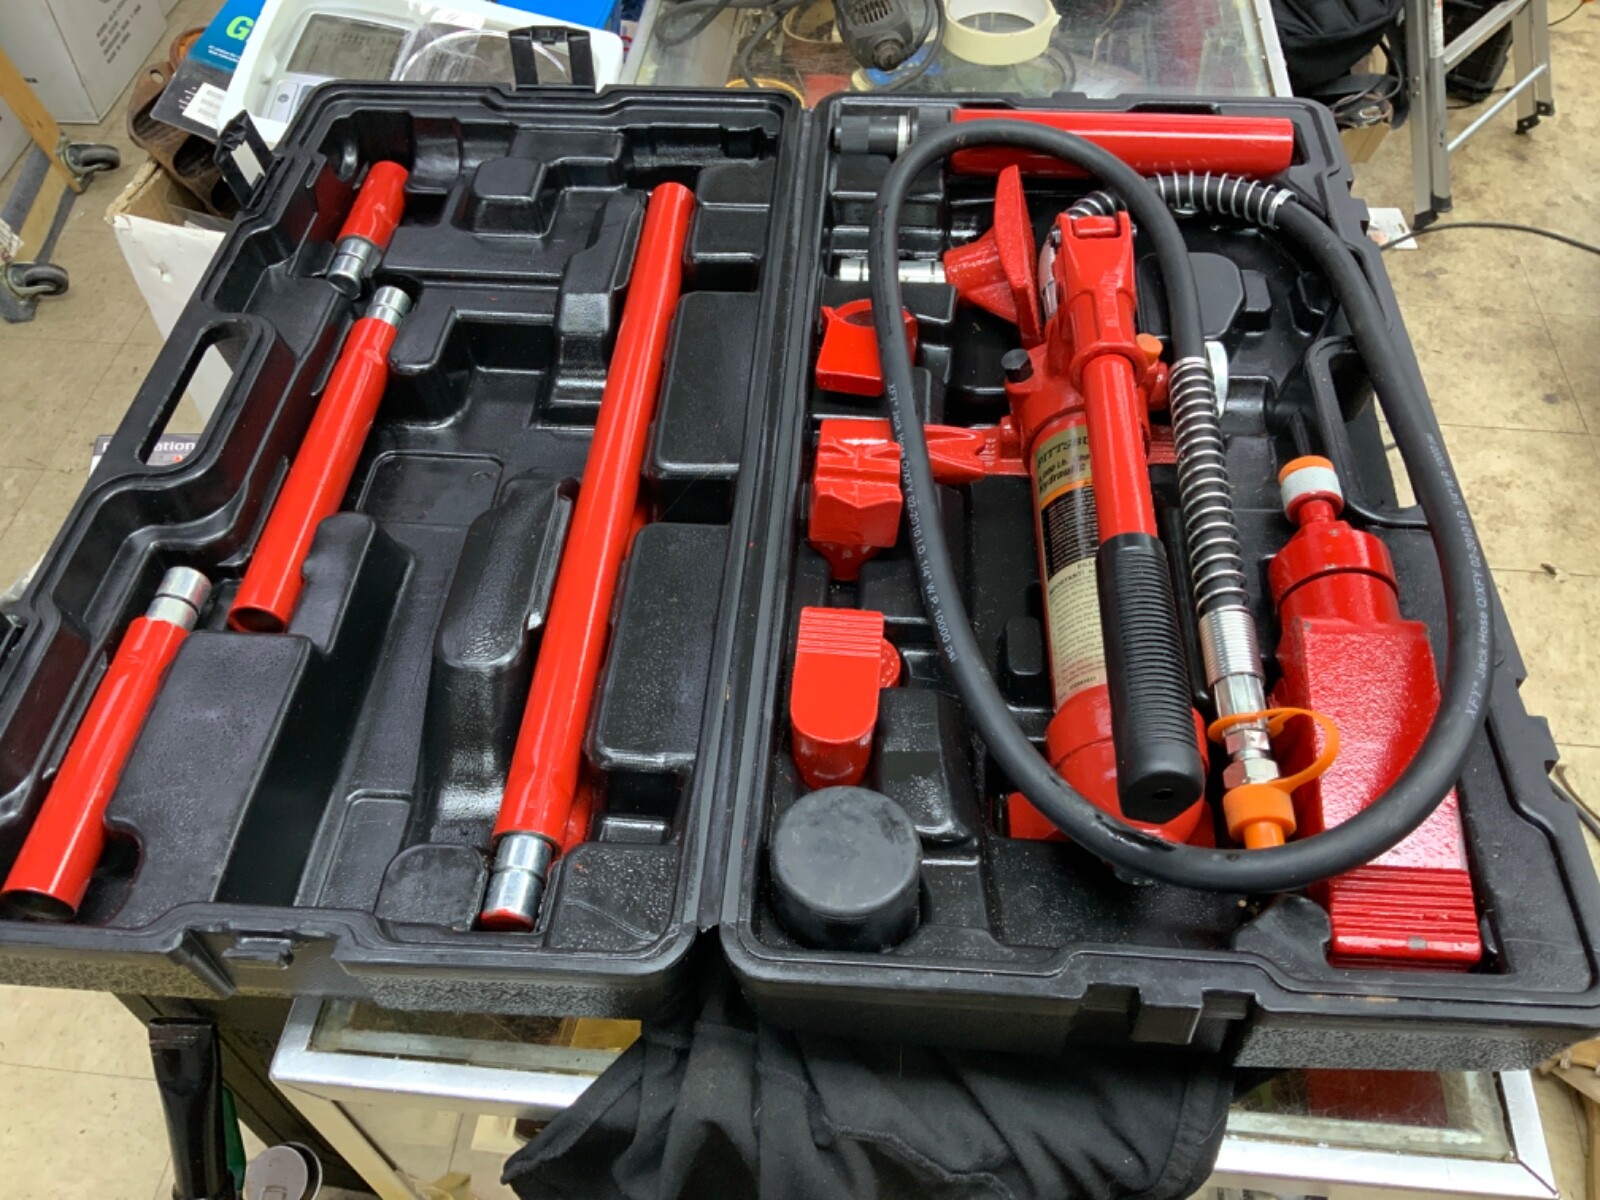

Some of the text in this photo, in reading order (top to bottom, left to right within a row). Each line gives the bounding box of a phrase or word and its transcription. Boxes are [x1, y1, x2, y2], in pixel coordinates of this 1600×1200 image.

[933, 609, 951, 643] 10000
[1479, 611, 1489, 643] Hose
[1475, 648, 1488, 678] Jack
